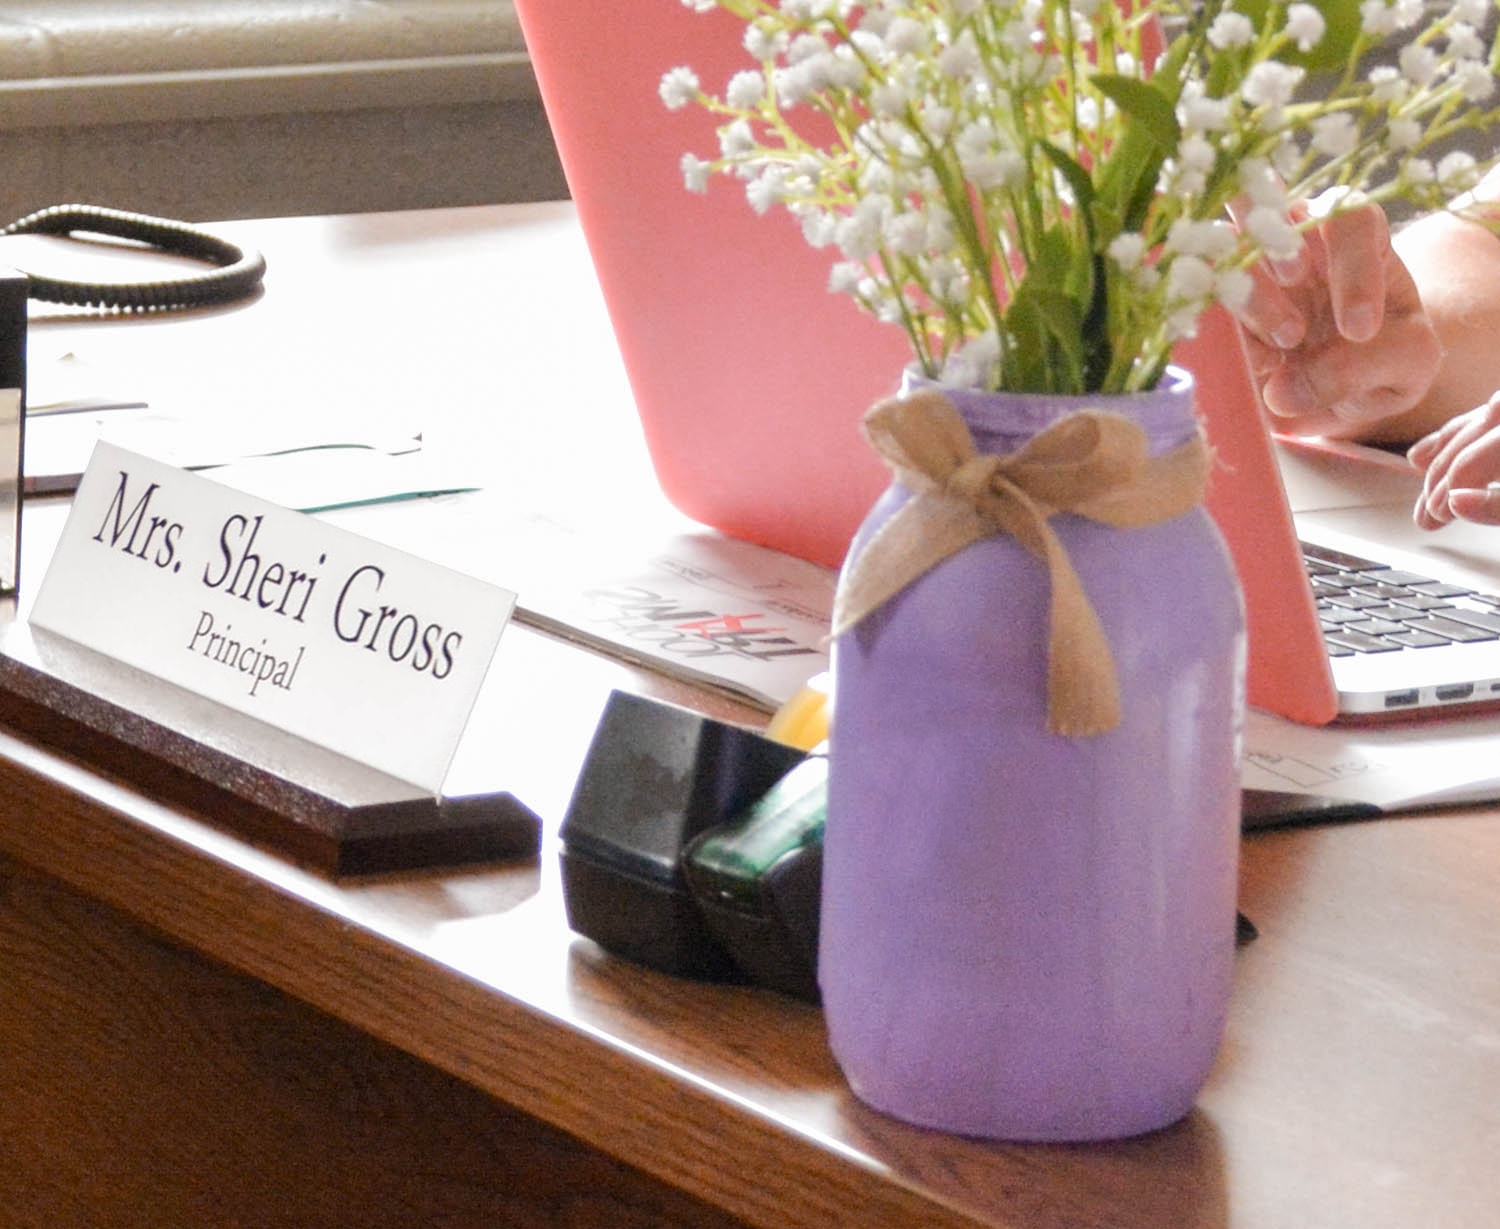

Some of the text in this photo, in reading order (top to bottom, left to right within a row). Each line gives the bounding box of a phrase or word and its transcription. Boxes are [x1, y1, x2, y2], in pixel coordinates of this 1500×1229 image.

[92, 470, 462, 679] Mrs. Sheri Gross
[187, 611, 307, 696] Principal
